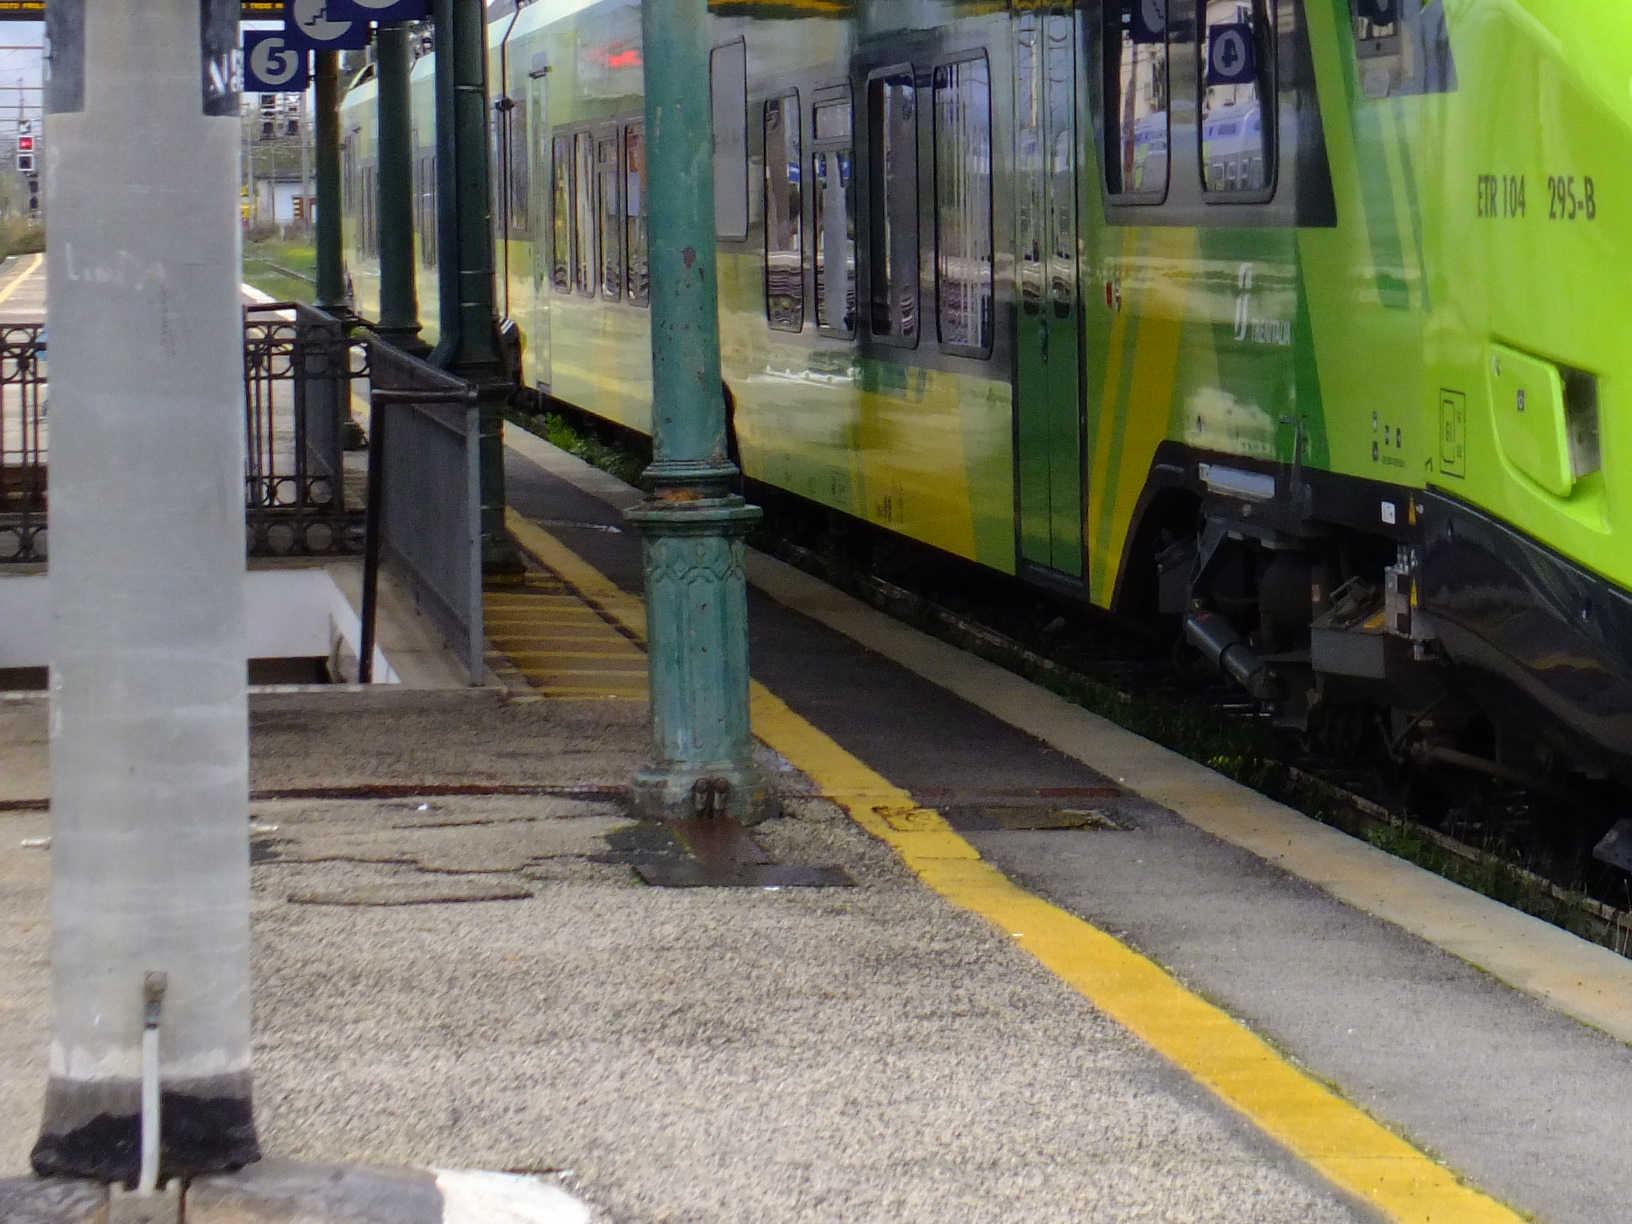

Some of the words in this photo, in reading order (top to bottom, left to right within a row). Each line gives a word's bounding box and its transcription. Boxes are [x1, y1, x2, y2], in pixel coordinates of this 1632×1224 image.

[264, 46, 288, 76] 5
[1477, 174, 1498, 218] ETR
[1502, 174, 1527, 218] 104
[1547, 175, 1597, 220] 295-B
